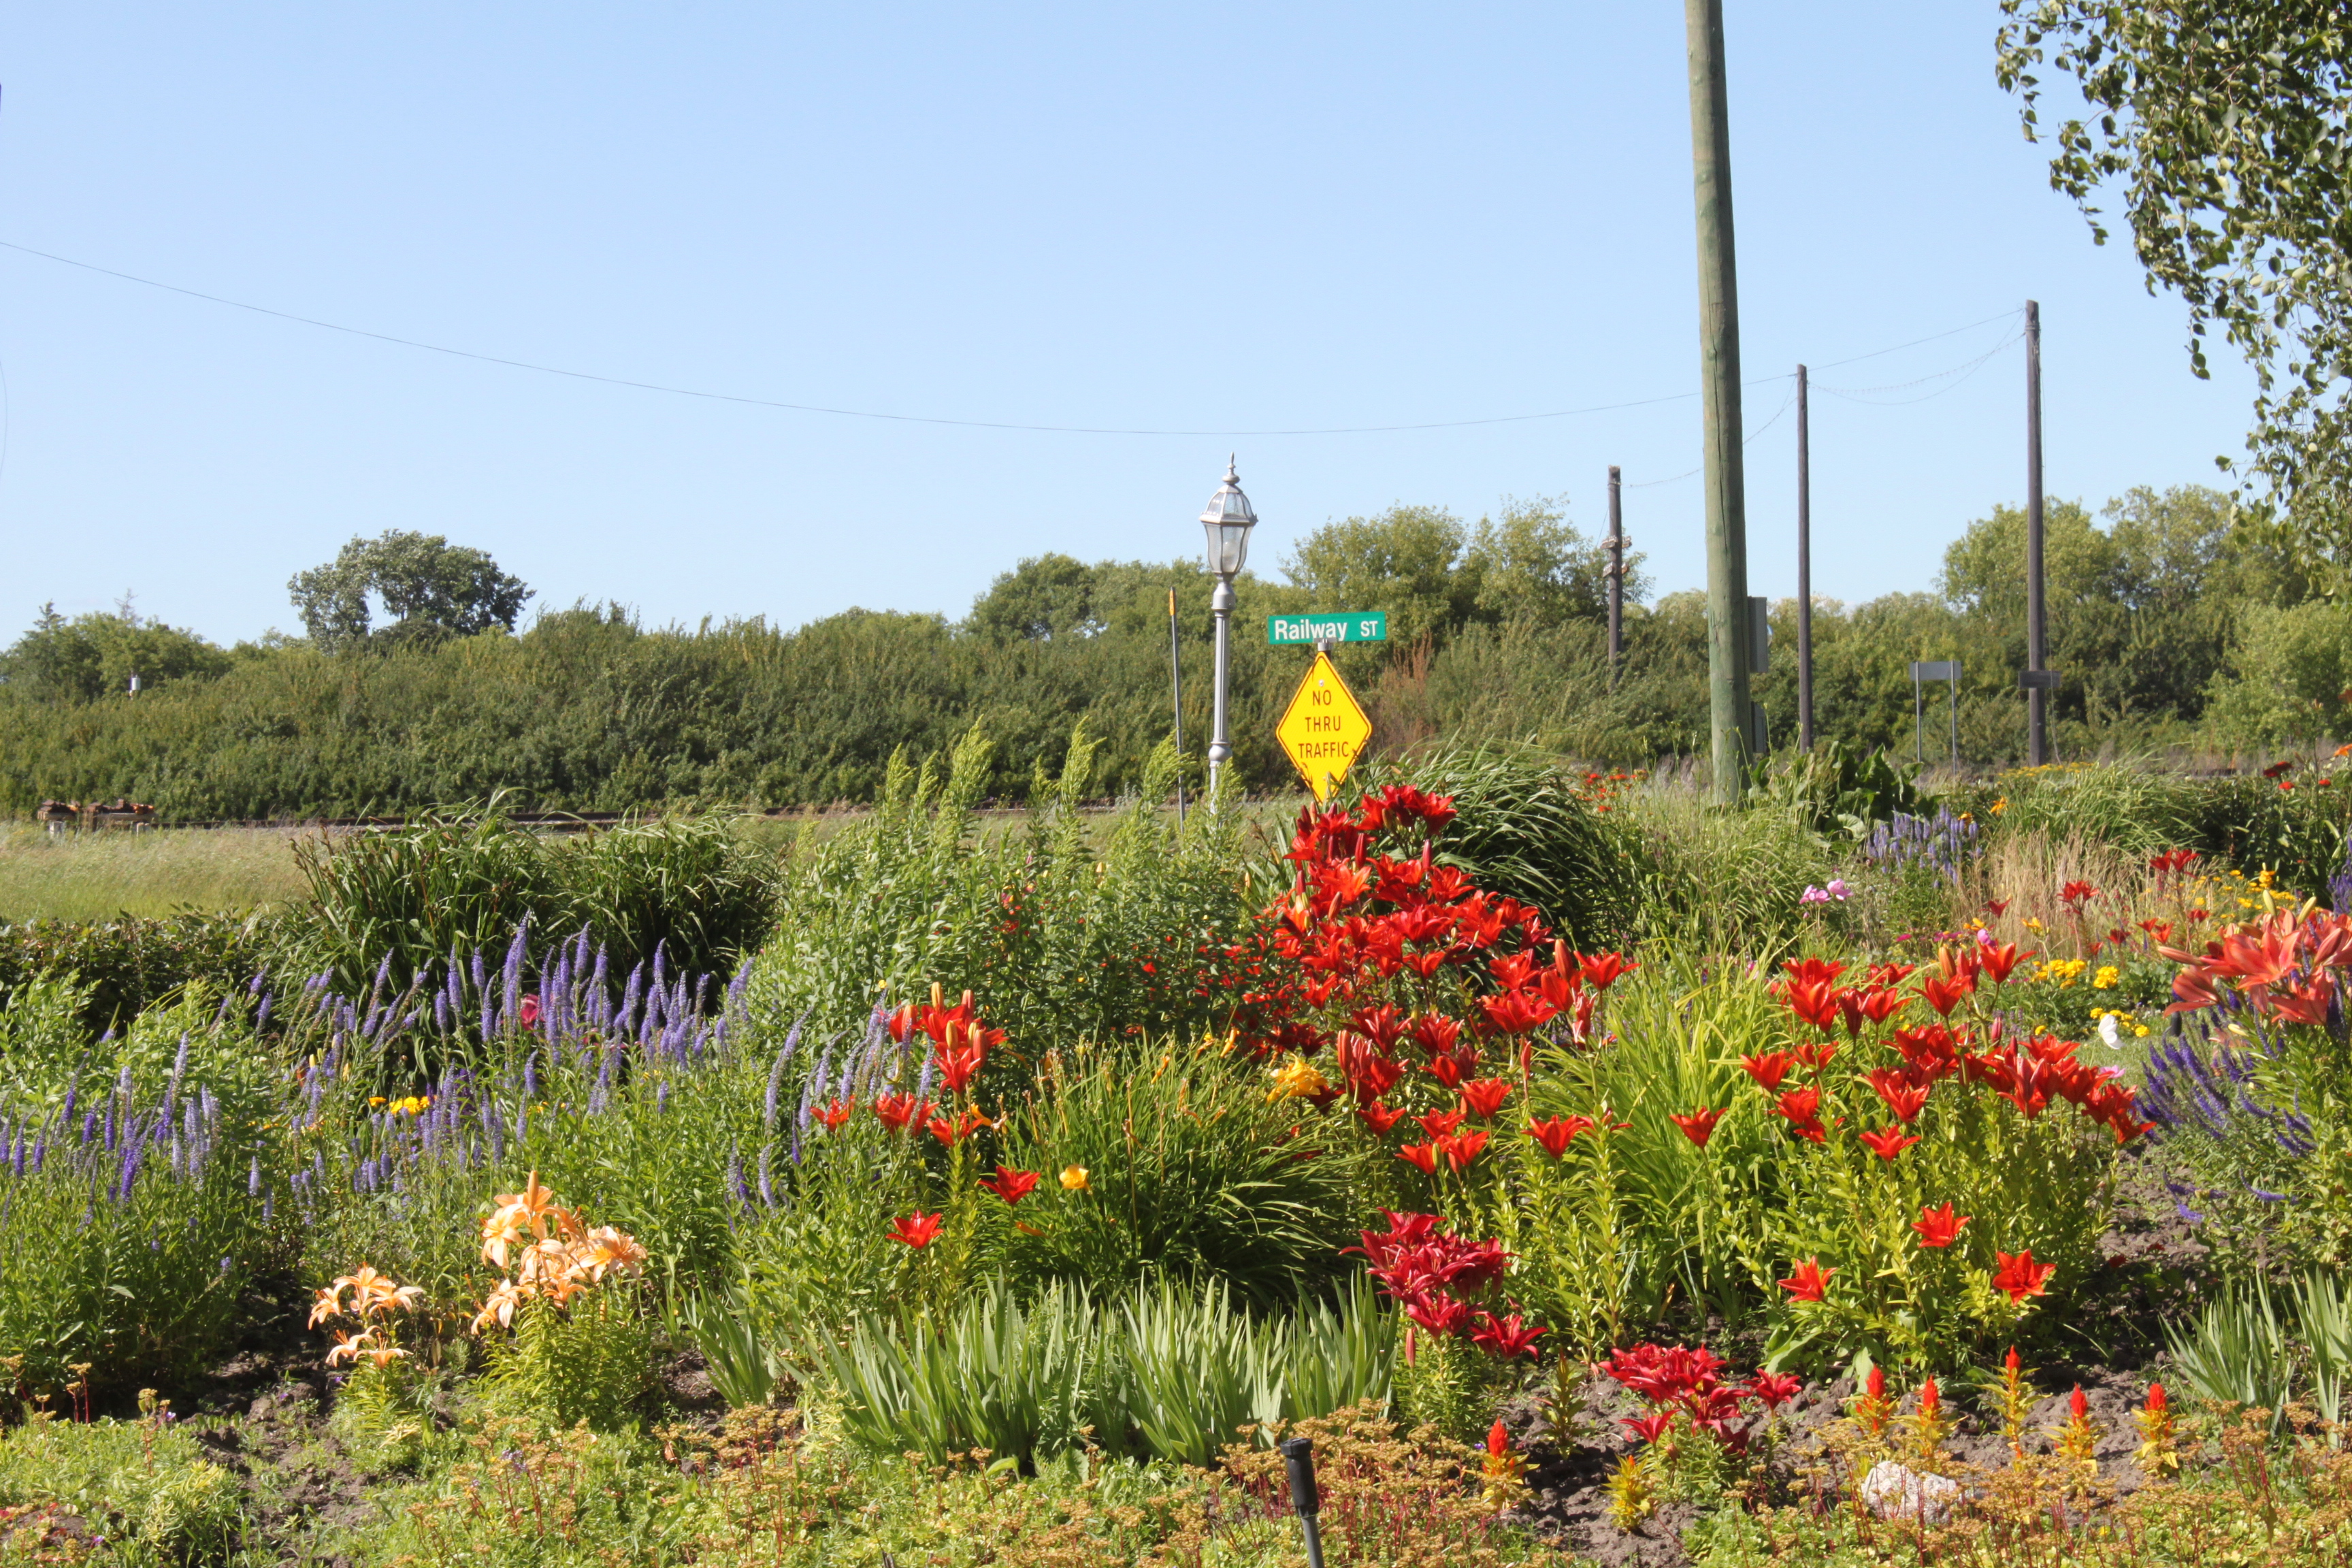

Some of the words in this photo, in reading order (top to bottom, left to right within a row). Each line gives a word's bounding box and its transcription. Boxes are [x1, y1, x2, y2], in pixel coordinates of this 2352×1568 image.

[1275, 619, 1348, 642] Railway
[1360, 620, 1378, 637] ST
[1312, 689, 1332, 706] NO
[1305, 715, 1341, 732] THRU
[1298, 741, 1349, 759] TRAFFIC
